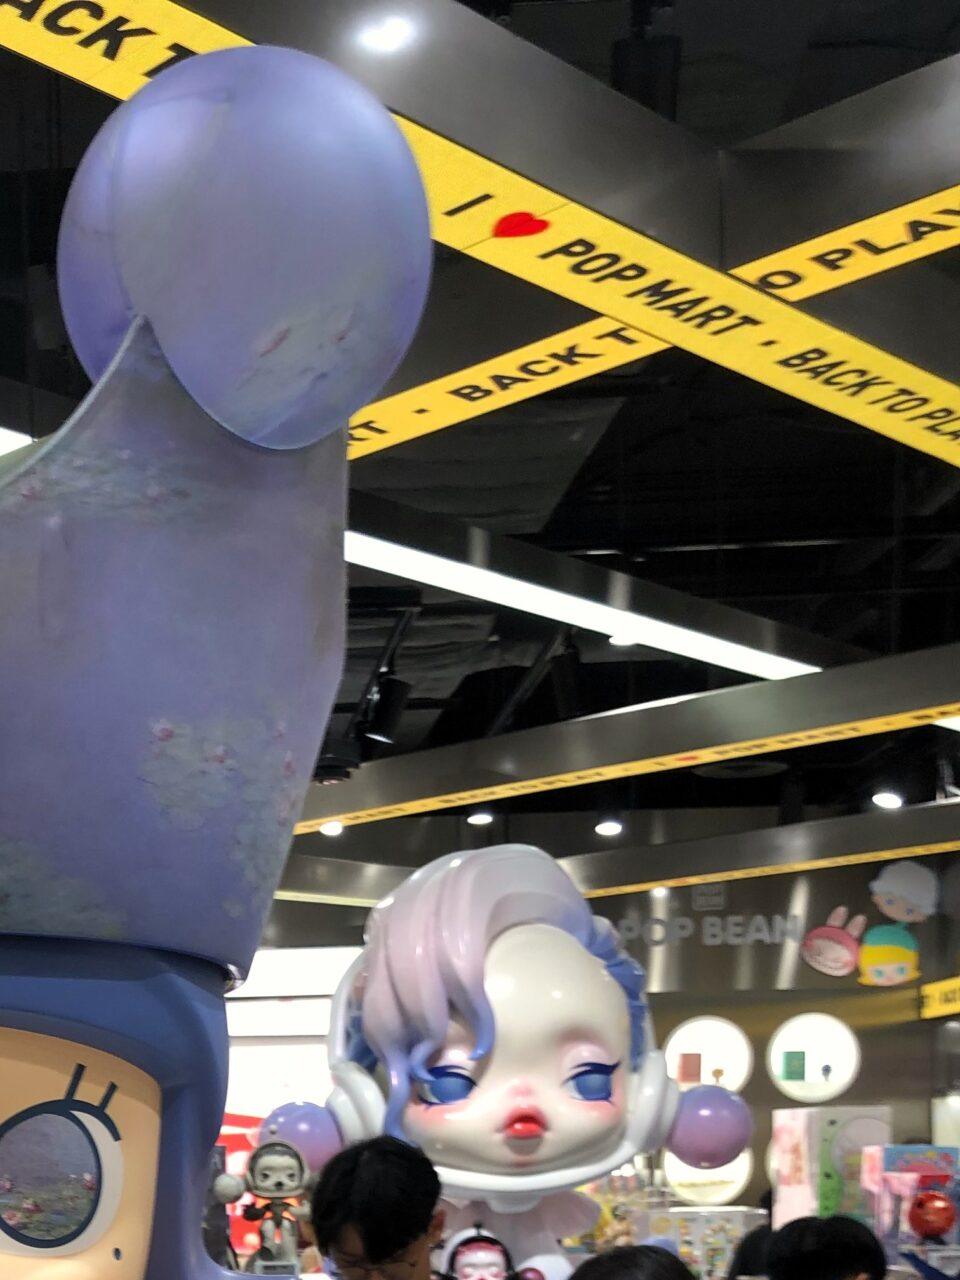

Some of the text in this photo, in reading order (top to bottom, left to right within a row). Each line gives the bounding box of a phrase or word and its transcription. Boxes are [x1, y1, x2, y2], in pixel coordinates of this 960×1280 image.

[141, 43, 199, 79] T
[806, 208, 960, 272] PLA
[441, 193, 494, 218] I
[537, 238, 649, 283] POP
[625, 279, 763, 336] MART
[774, 347, 895, 398] BACK
[868, 388, 932, 414] TO
[446, 343, 606, 402] BACK
[591, 326, 642, 346] T
[701, 914, 806, 947] BEAN
